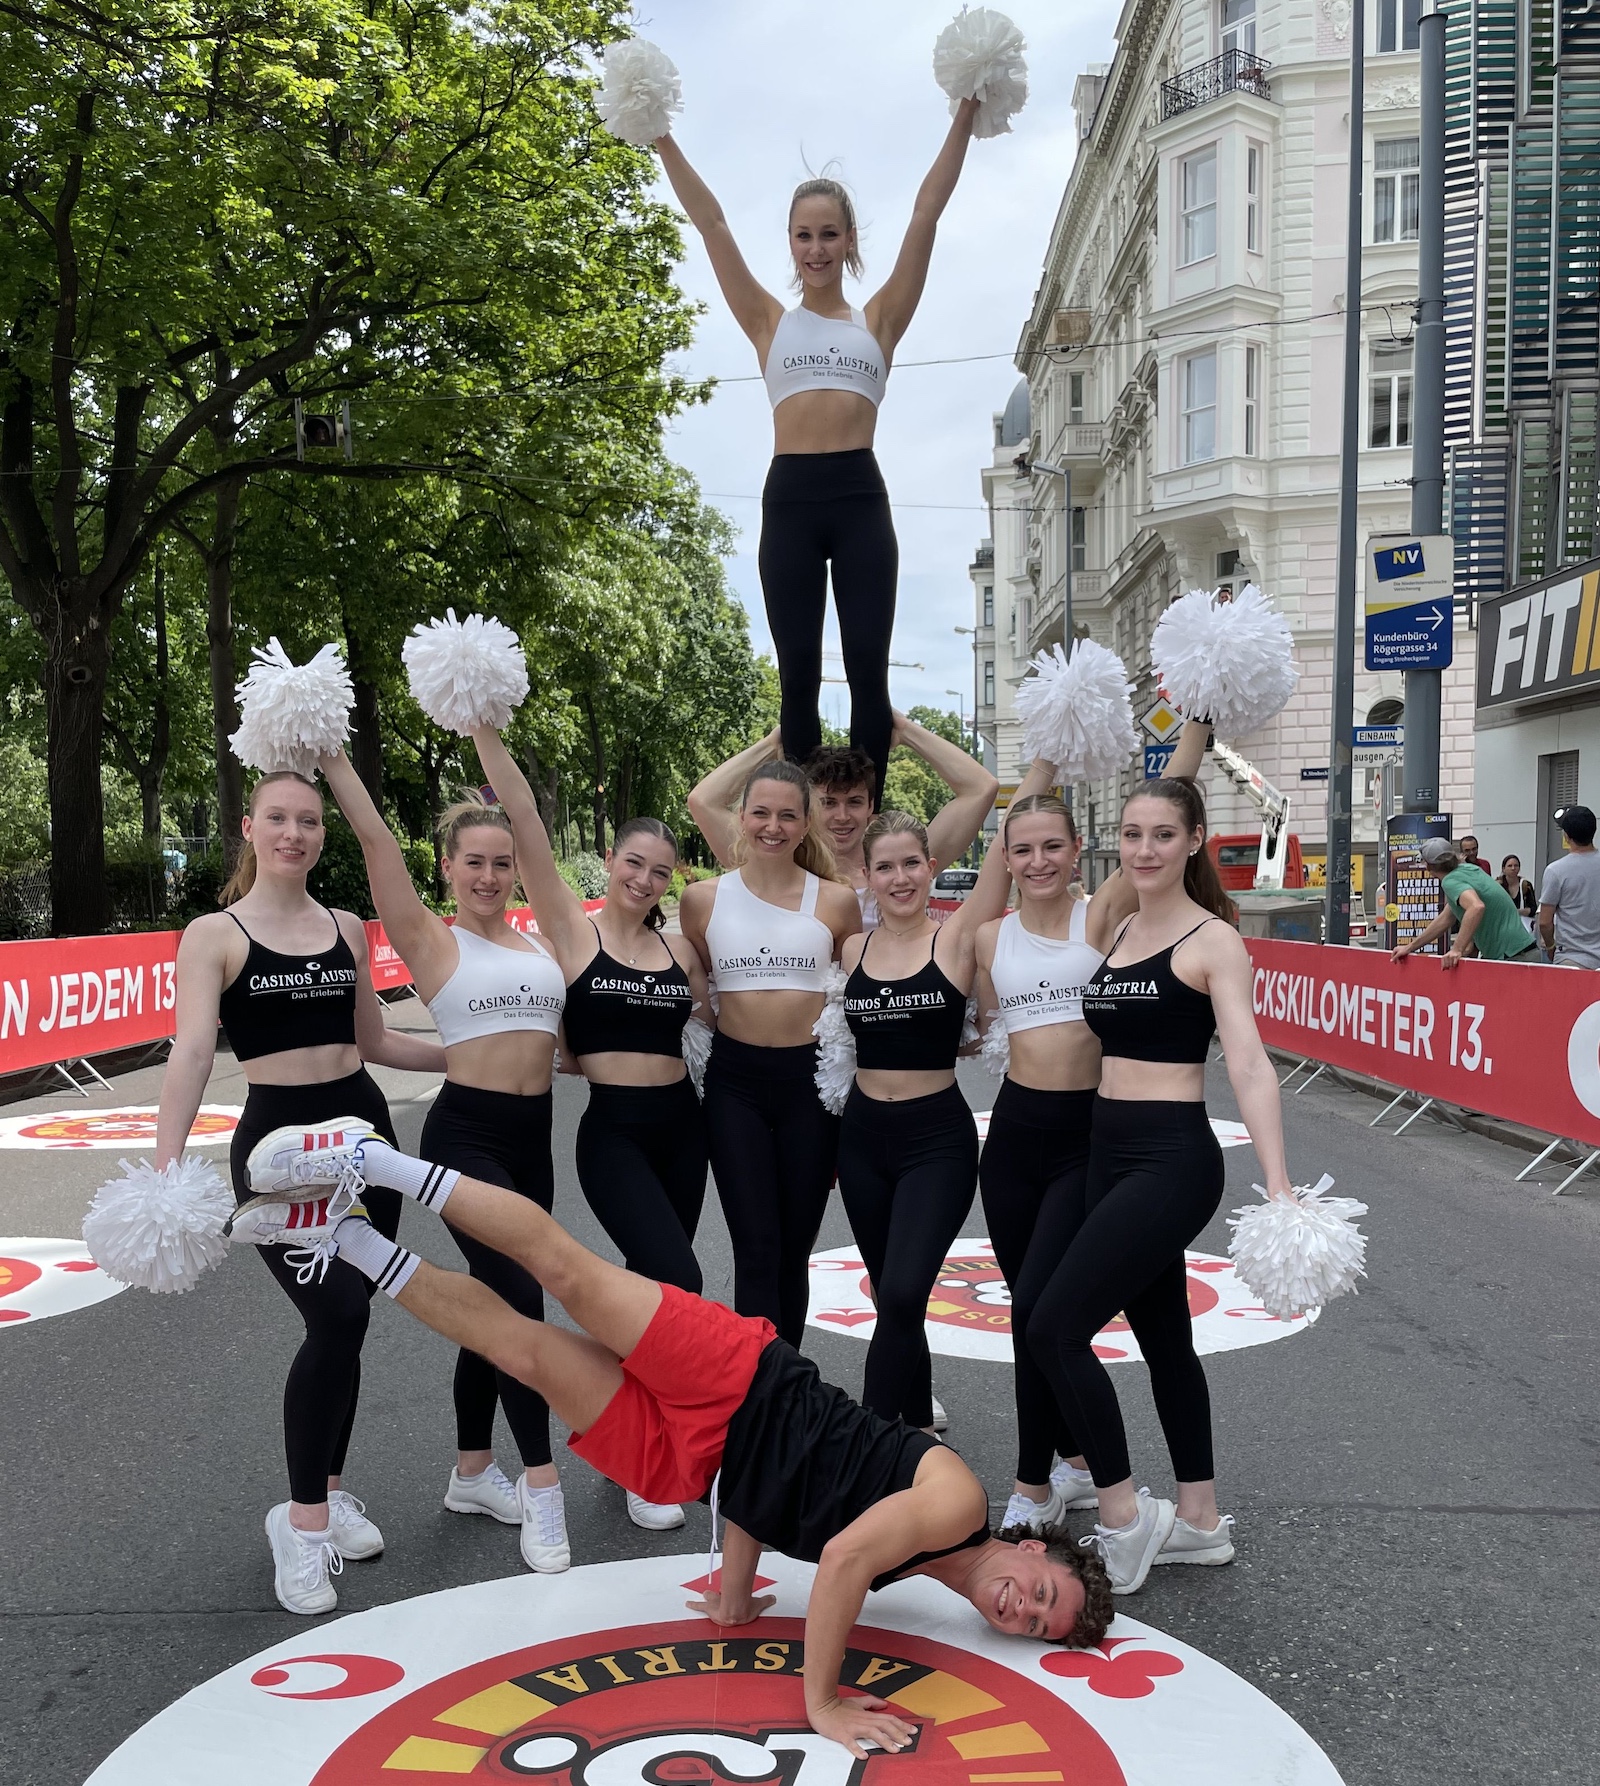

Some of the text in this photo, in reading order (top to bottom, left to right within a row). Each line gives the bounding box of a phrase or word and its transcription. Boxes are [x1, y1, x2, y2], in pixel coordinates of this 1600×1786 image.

[783, 355, 878, 379] CASINOS AUSTRIA
[827, 371, 854, 379] Erlebnis.
[1393, 549, 1419, 564] NV
[1373, 632, 1429, 642] Kundenbüro
[1373, 642, 1438, 655] Rögergasse 34
[1359, 731, 1396, 741] EINBAHN
[1397, 887, 1439, 896] SEVENFOLD
[1426, 903, 1439, 911] ME
[718, 956, 816, 970] CASINOS AUSTRIA
[250, 973, 312, 990] CASINOS
[591, 977, 647, 993] CASINOS
[1102, 980, 1159, 996] AUSTRIA
[39, 965, 144, 1032] JEDEM
[468, 995, 521, 1012] CASINOS
[643, 999, 677, 1008] Erlebnis.
[887, 990, 945, 1008] AUSTRIA
[1000, 992, 1043, 1009] CASINOS
[878, 1012, 912, 1021] Erlebnis.
[1042, 1004, 1072, 1014] Erlebnis.
[1448, 1001, 1492, 1075] 13.
[536, 1642, 911, 1694] ASTRIA
